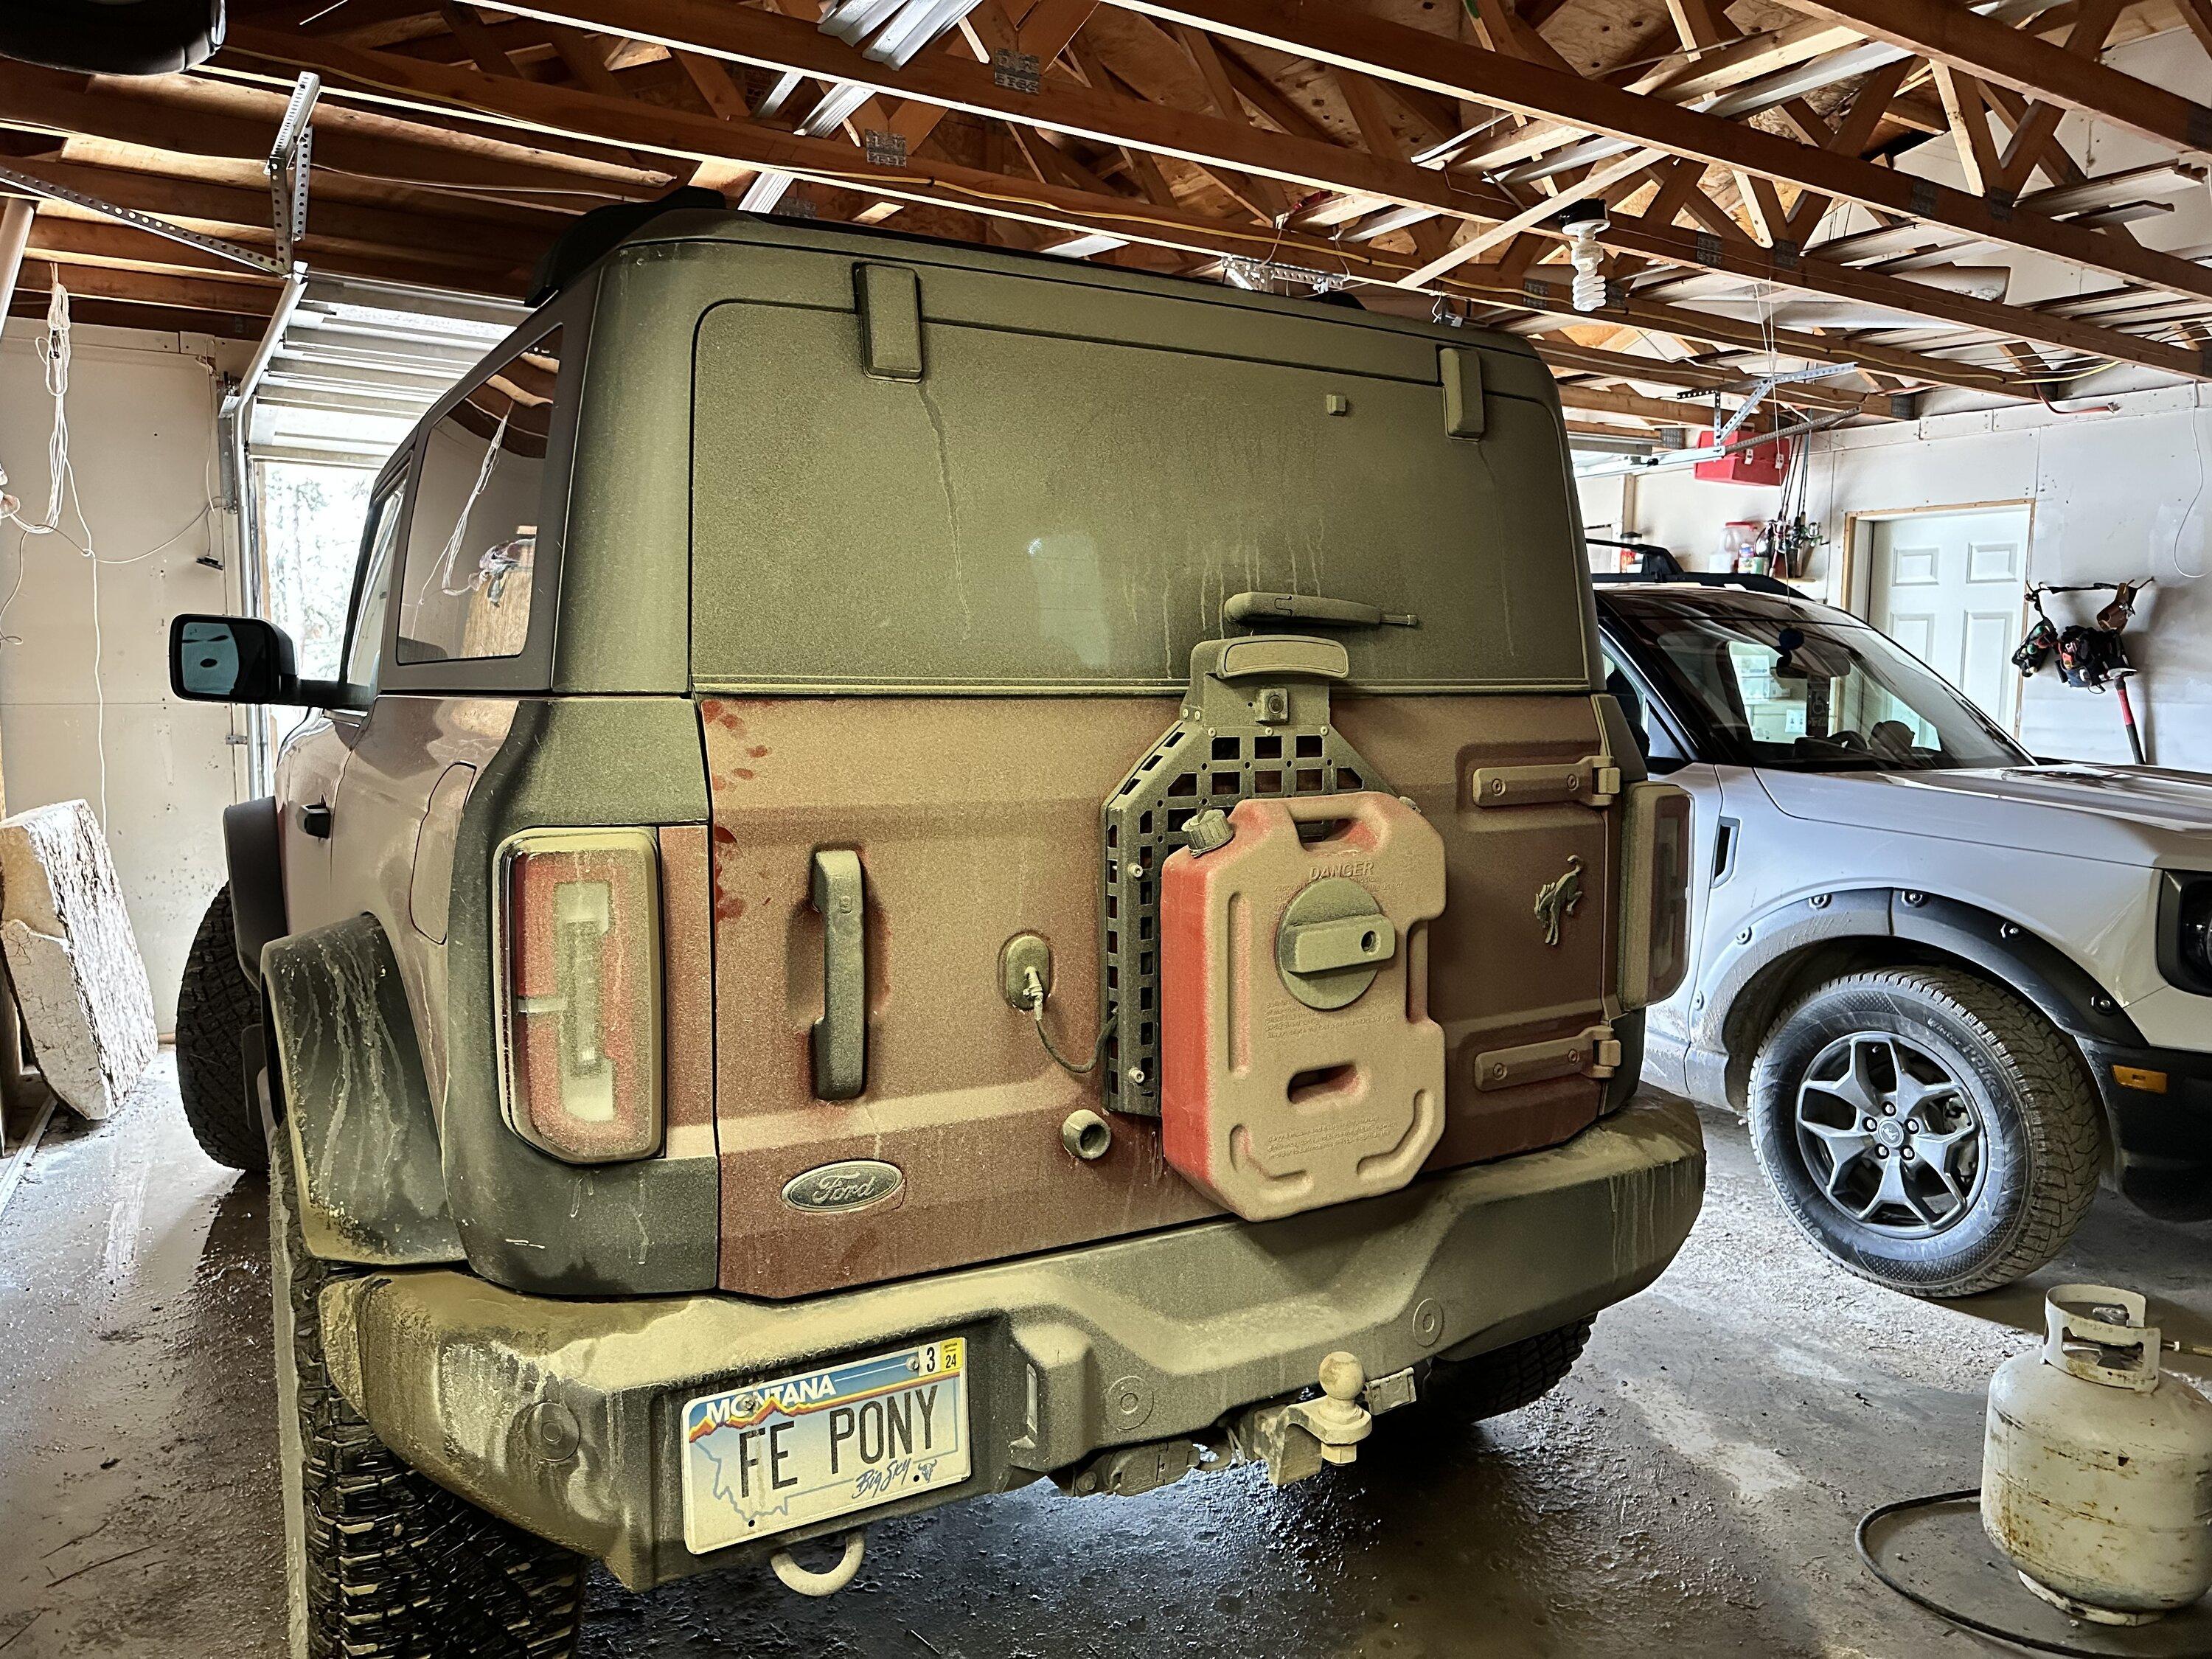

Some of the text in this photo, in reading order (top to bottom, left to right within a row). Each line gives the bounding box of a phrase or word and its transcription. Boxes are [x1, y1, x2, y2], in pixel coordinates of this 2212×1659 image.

[1309, 861, 1374, 881] DANGER
[813, 1172, 877, 1203] Ford
[926, 1346, 935, 1372] 3
[945, 1353, 956, 1368] 24
[706, 1374, 836, 1422] MONTANA
[739, 1385, 939, 1498] FE PONY
